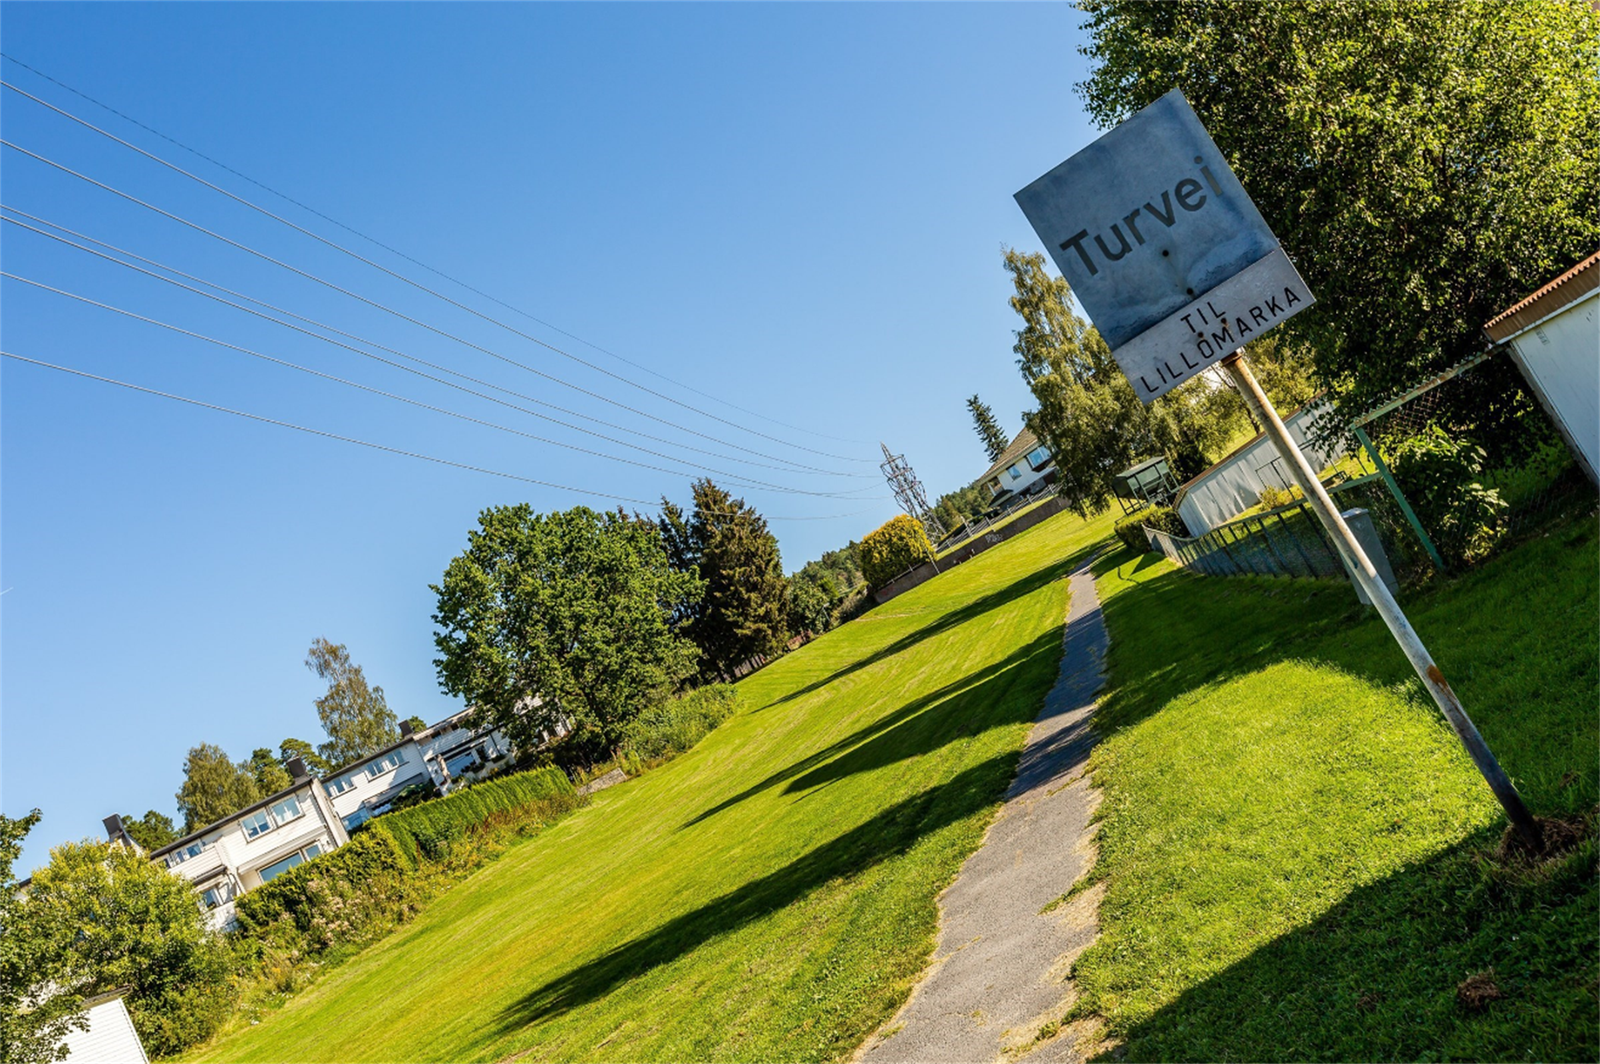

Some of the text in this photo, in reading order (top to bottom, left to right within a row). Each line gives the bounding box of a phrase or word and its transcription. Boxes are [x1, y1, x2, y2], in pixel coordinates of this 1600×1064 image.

[1059, 155, 1222, 276] Turvei
[1140, 287, 1301, 393] LILLOMARKA
[1180, 301, 1226, 333] TIL
